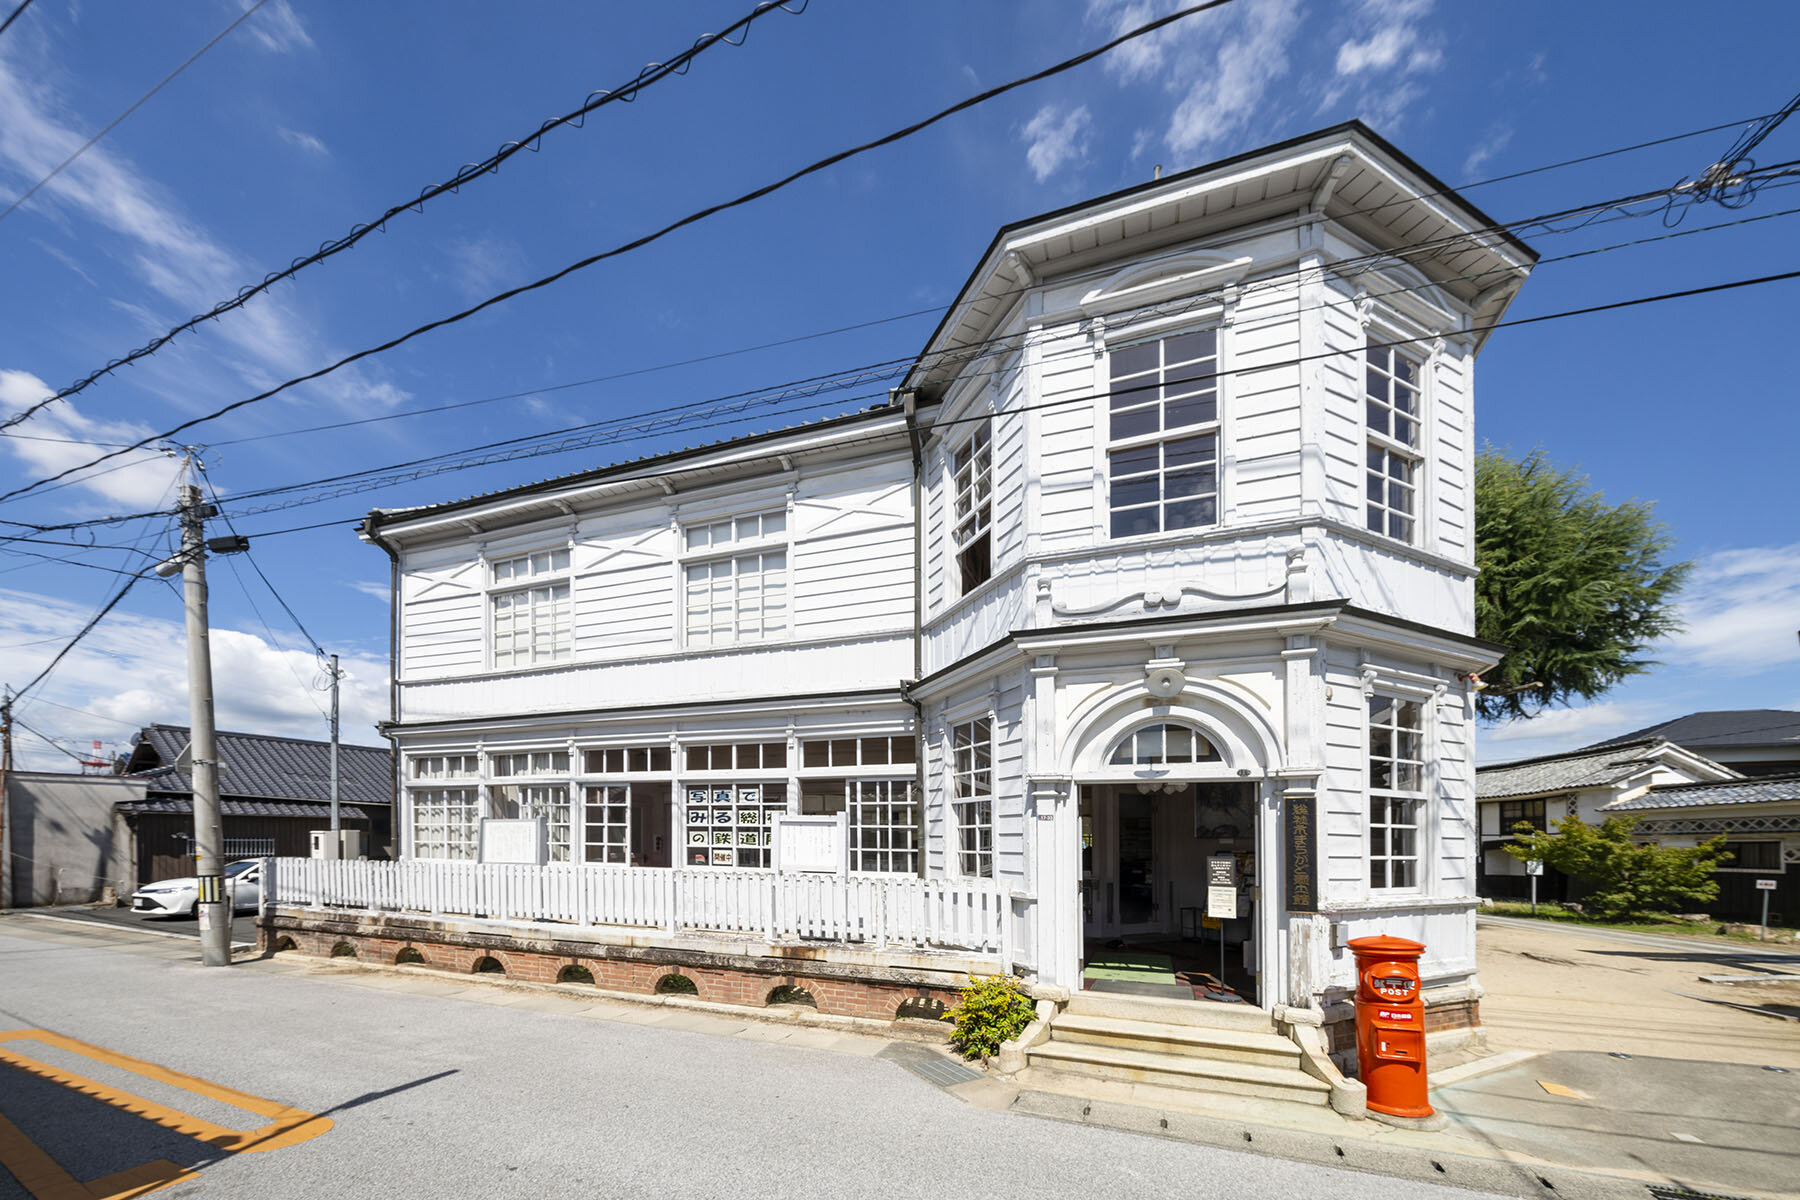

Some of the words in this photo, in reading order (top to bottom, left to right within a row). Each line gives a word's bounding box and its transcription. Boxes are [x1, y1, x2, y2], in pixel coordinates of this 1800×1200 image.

[690, 790, 756, 803] 写真で
[1380, 988, 1409, 996] POST
